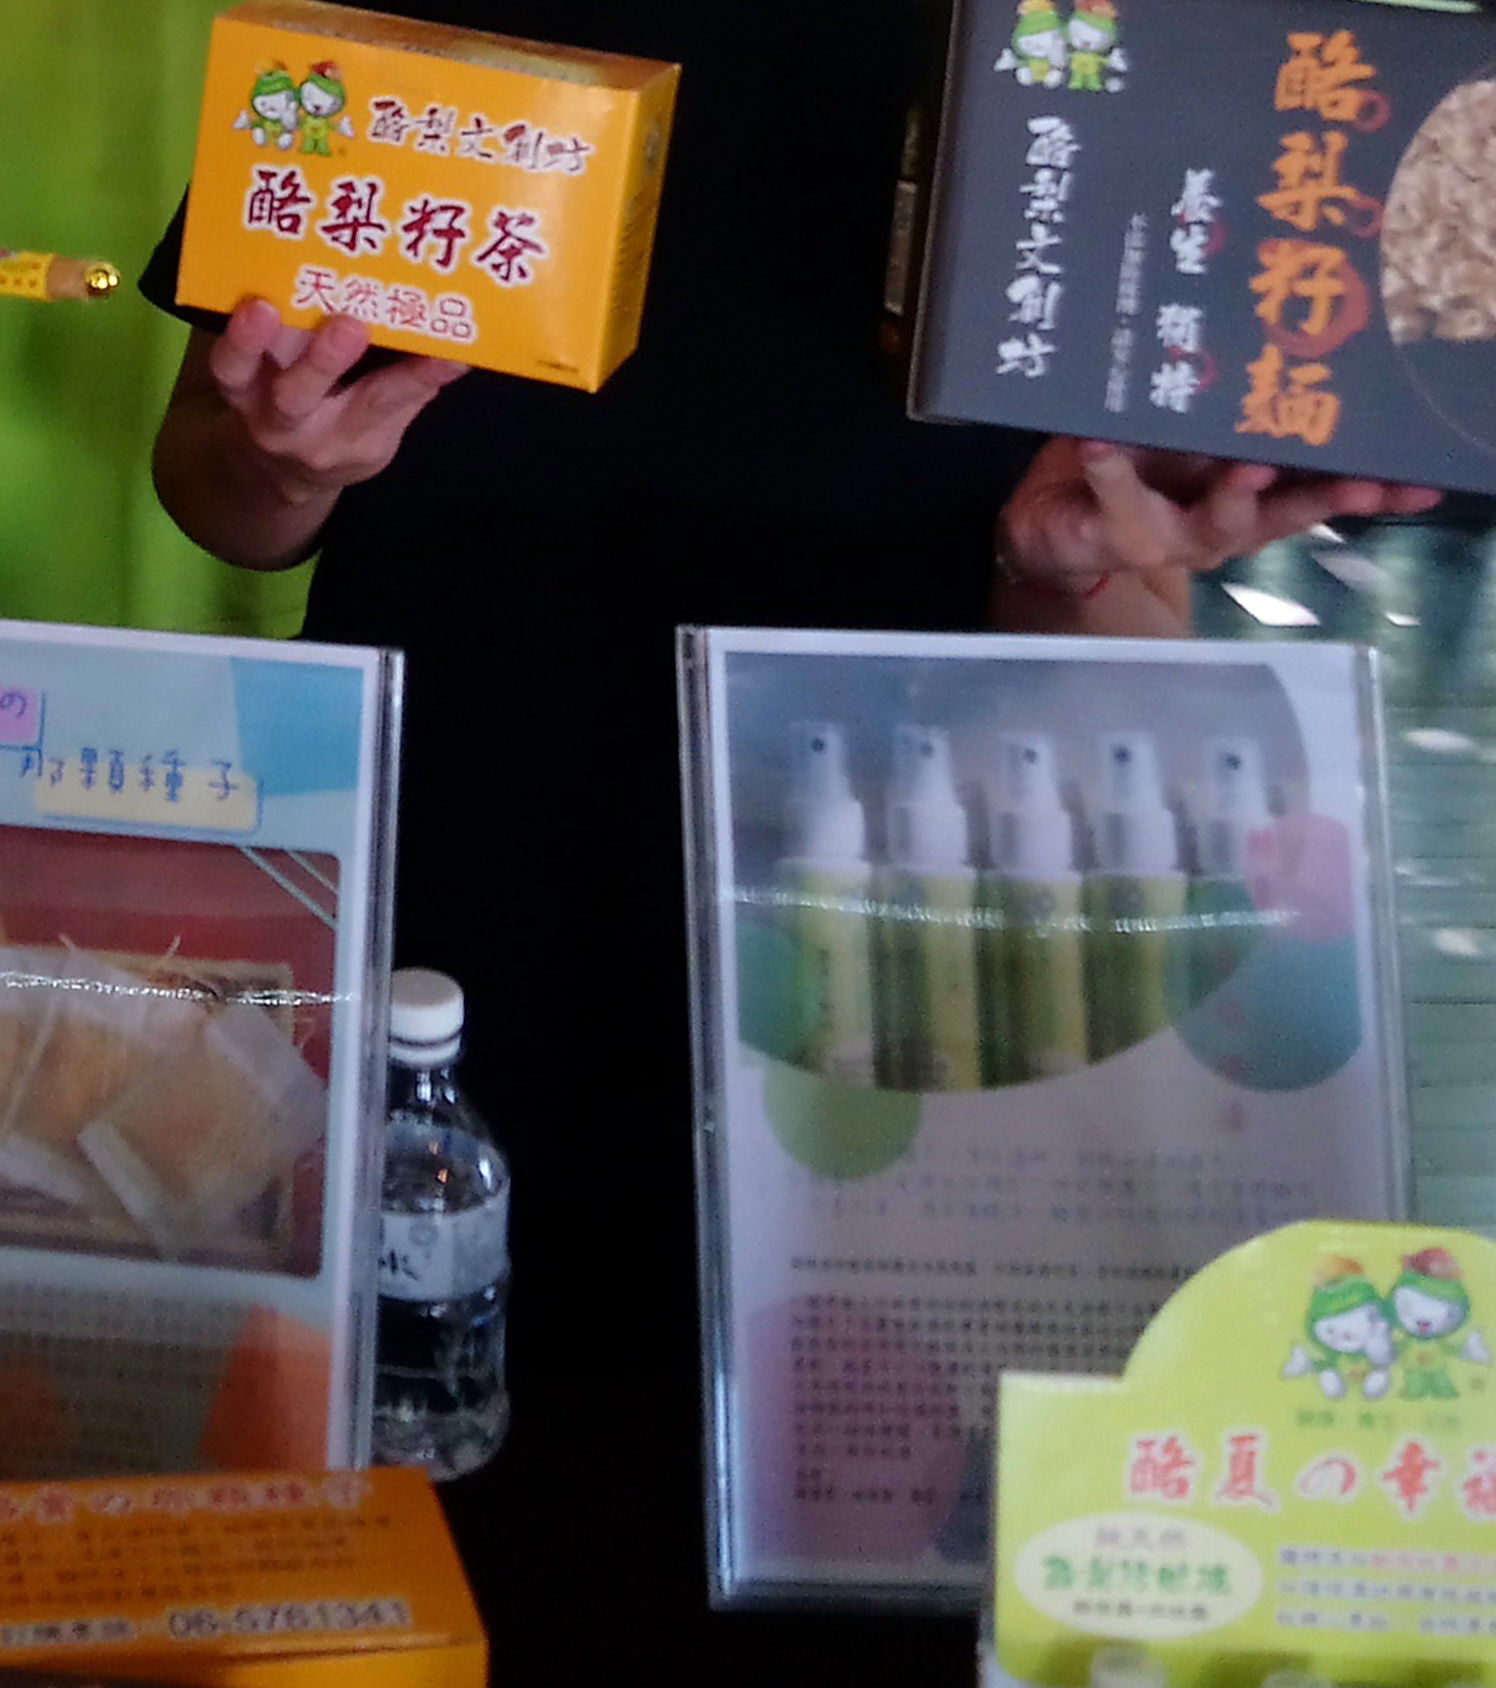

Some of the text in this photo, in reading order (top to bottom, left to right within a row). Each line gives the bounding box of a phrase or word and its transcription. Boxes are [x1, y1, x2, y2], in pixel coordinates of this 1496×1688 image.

[245, 169, 548, 284] 酪梨籽茶
[293, 268, 474, 341] 天然極品
